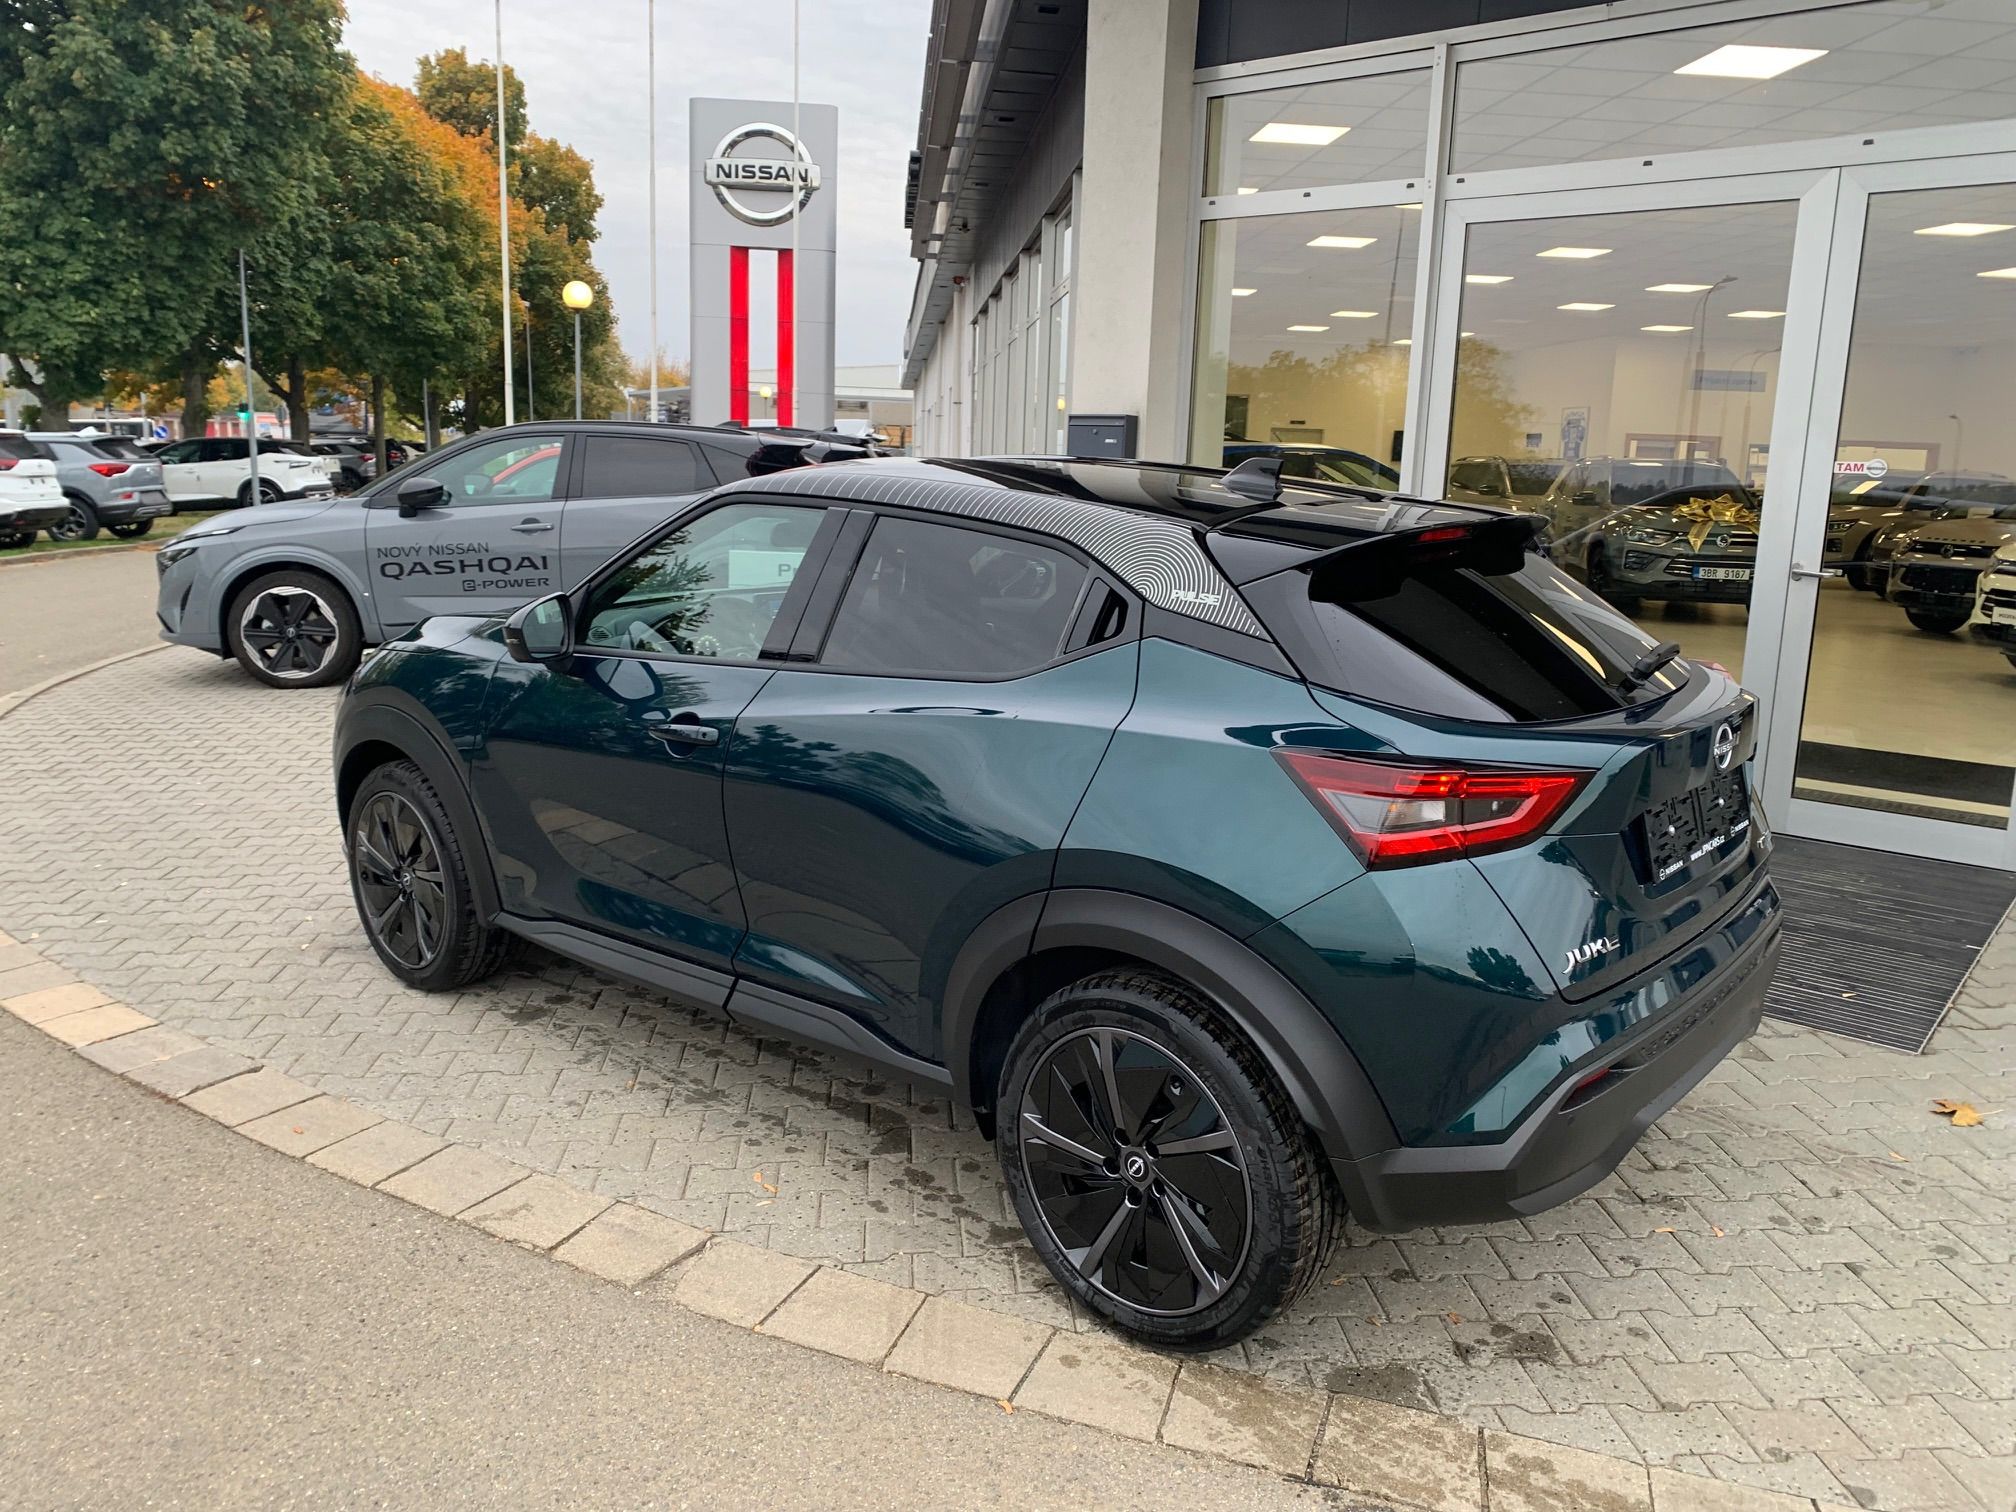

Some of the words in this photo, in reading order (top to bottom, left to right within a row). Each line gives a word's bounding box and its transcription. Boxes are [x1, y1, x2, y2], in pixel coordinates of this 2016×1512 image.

[716, 163, 808, 182] NISSAN
[1837, 463, 1864, 472] TAM
[377, 543, 422, 558] NOVÝ
[429, 541, 490, 556] NISSAN
[380, 556, 548, 580] QASHQAI
[1561, 937, 1621, 974] JUKE
